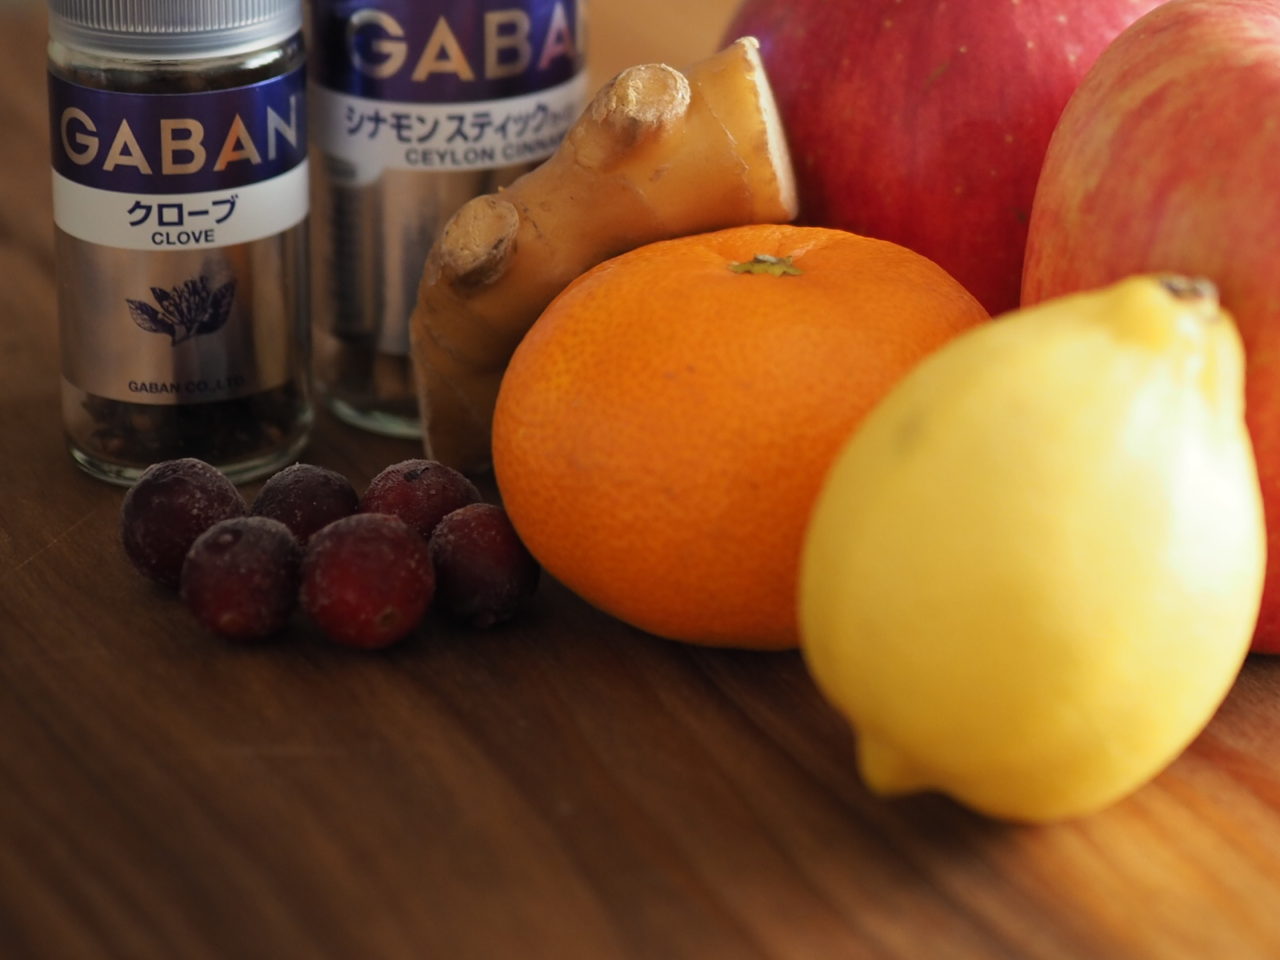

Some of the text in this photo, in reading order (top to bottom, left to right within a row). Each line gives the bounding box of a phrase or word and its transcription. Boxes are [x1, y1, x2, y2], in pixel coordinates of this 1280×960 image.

[61, 95, 297, 175] GABAN
[405, 146, 496, 167] CEYLON
[127, 194, 239, 226] クローブ
[151, 229, 215, 245] CLOVE
[128, 380, 180, 394] GABAN
